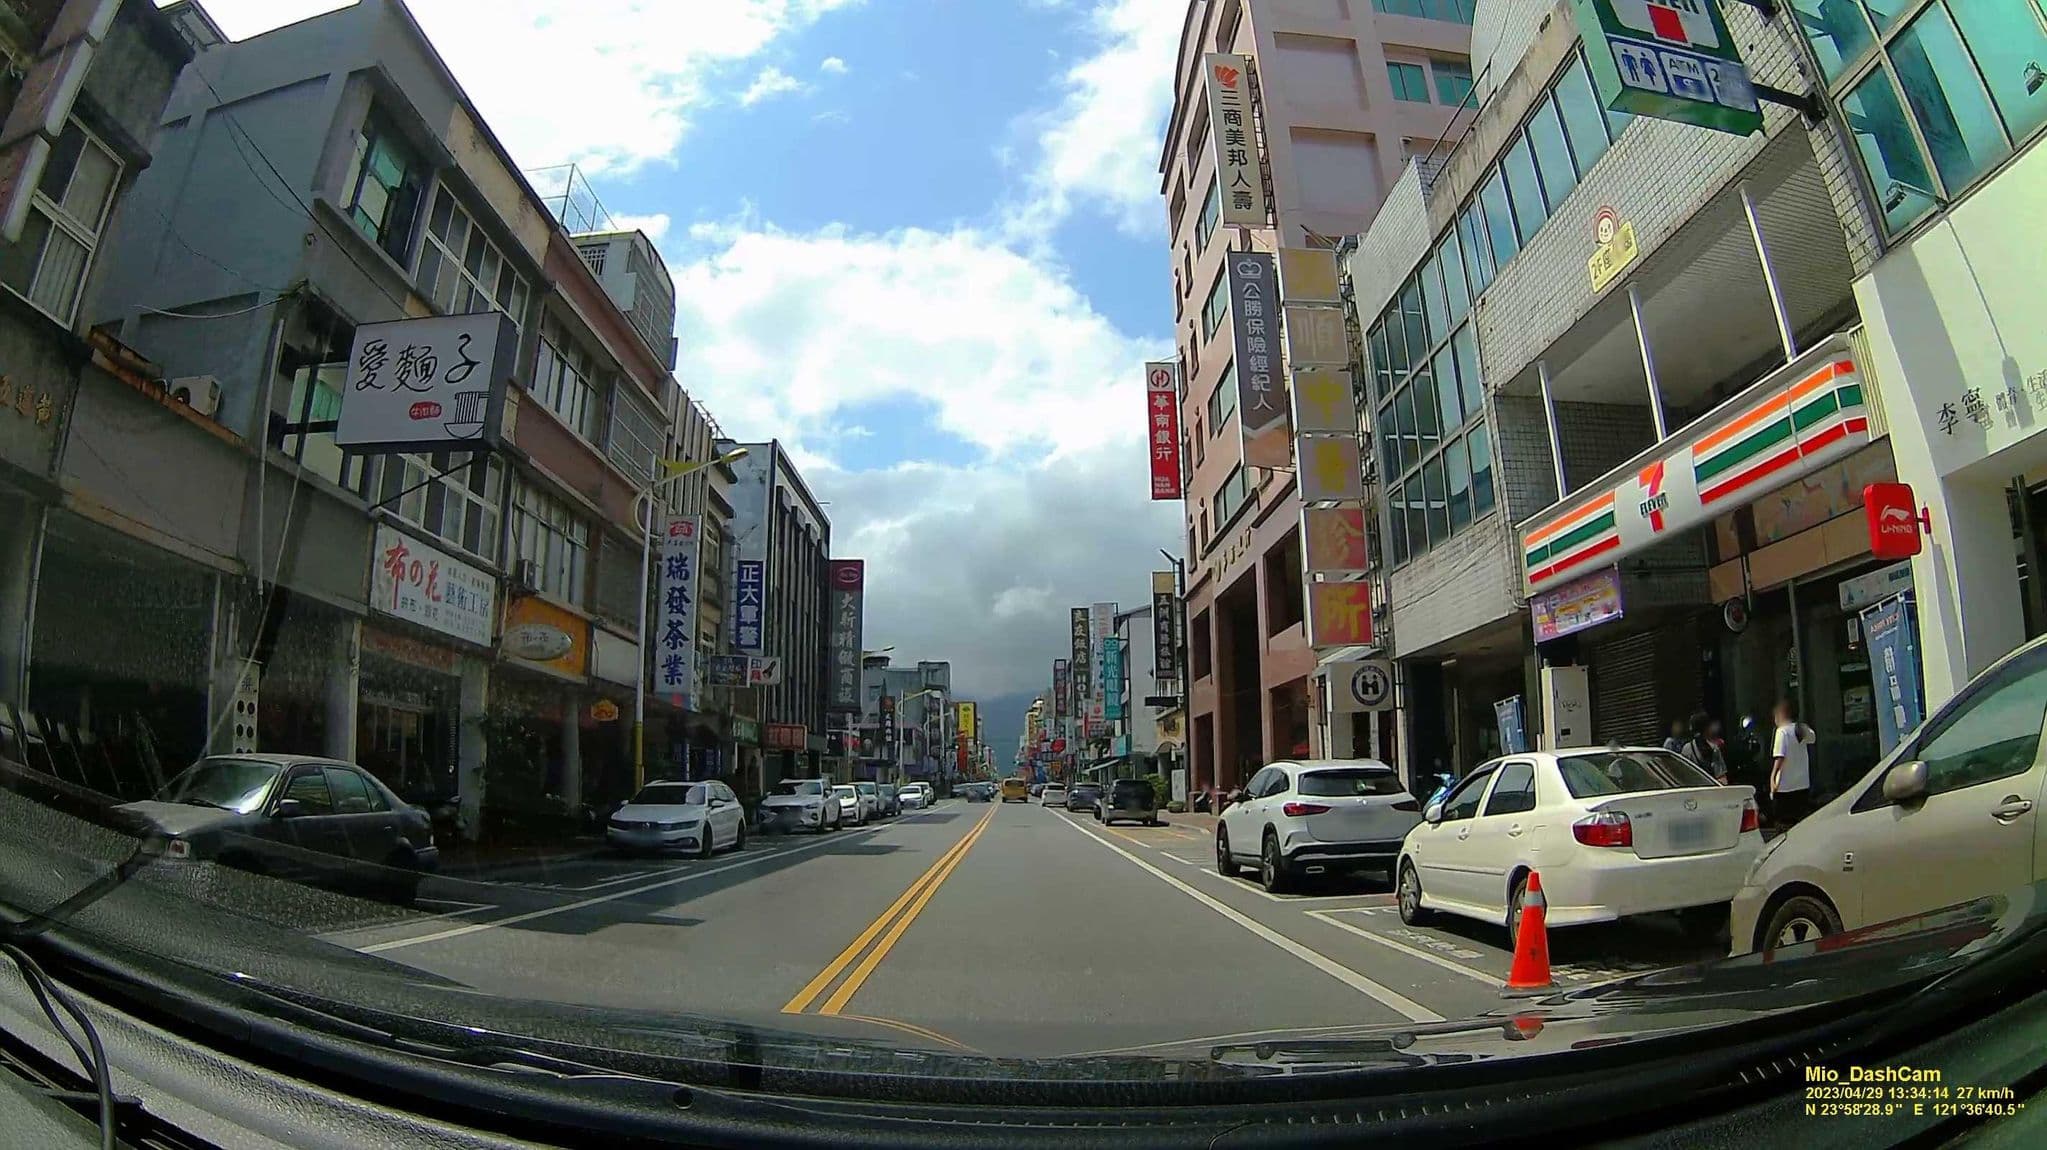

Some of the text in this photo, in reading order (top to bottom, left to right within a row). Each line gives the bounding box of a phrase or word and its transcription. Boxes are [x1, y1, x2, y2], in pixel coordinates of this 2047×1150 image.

[1668, 57, 1700, 75] ATM
[1221, 90, 1253, 210] 三商美邦人壽
[355, 332, 482, 392] 愛麵子
[1242, 282, 1273, 411] 公勝保險經紀人
[1154, 394, 1172, 461] 華南銀行
[1936, 386, 1985, 436] 李寧
[384, 537, 443, 610] 布の花
[661, 552, 691, 686] 瑞發茶業
